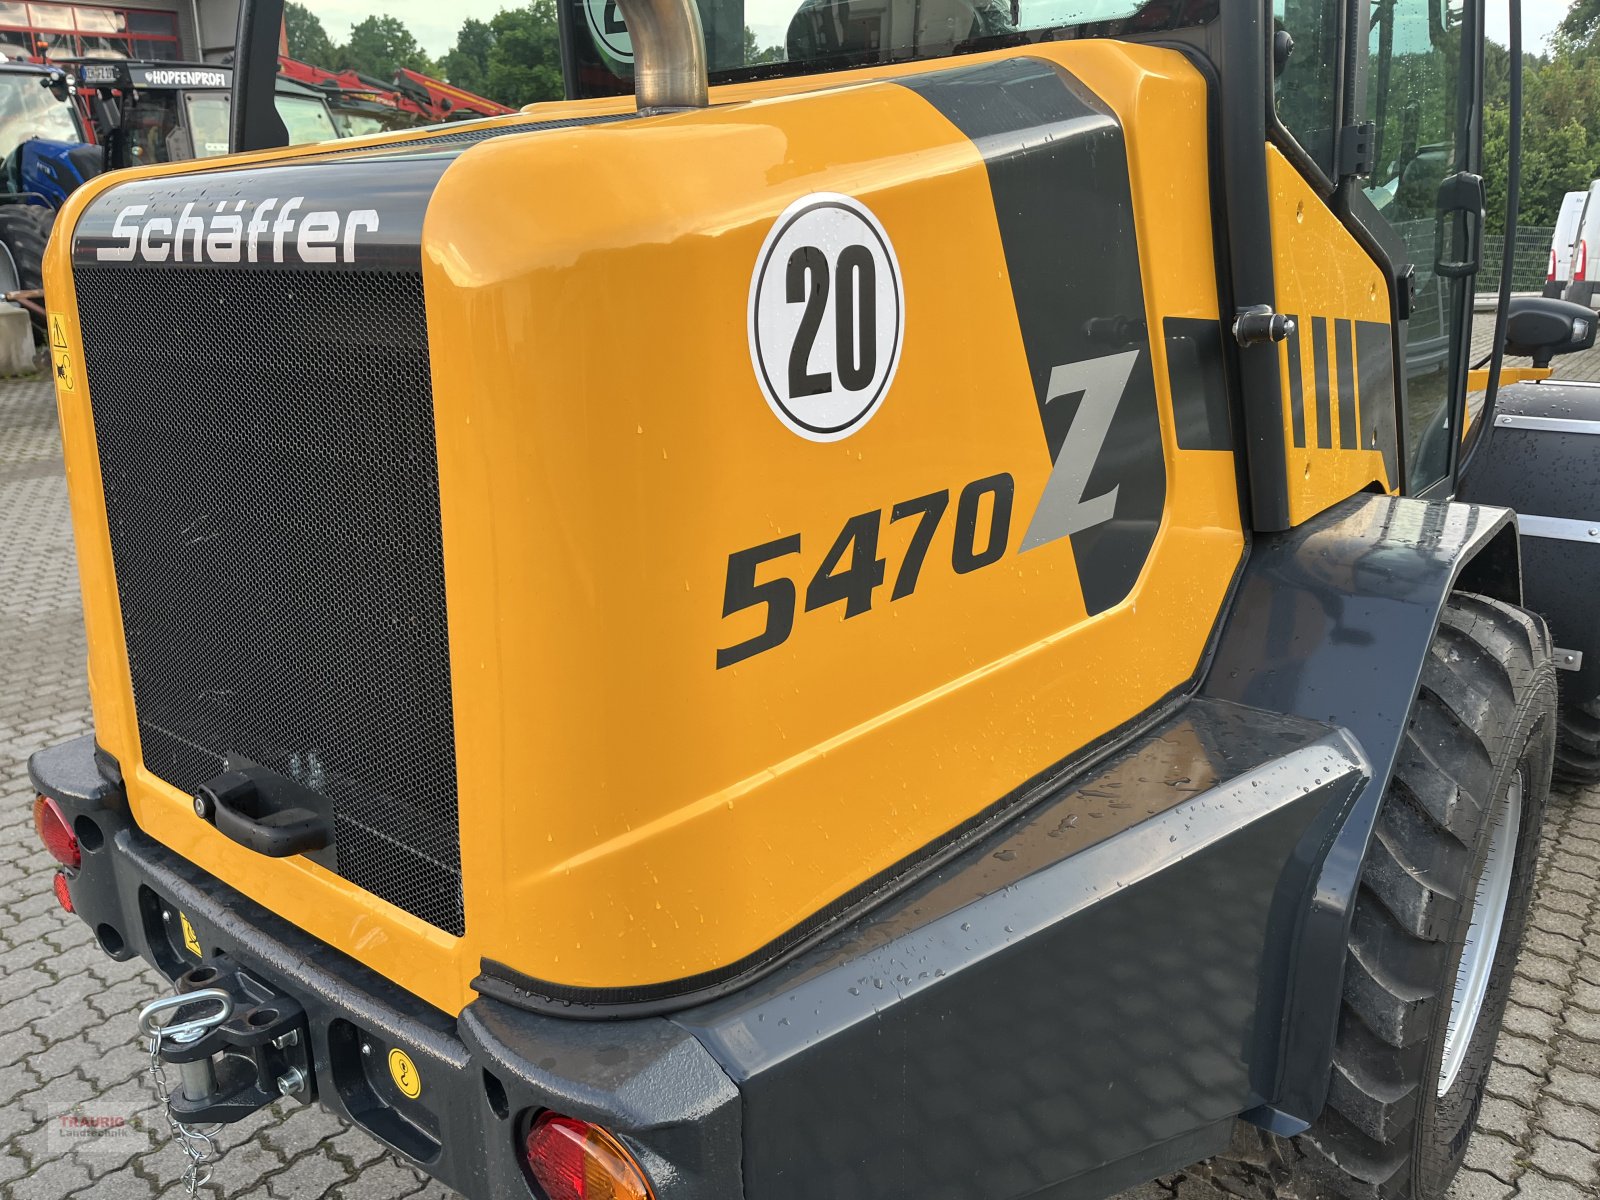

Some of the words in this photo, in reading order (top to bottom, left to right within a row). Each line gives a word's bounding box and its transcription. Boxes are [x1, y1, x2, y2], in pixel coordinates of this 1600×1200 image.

[152, 70, 226, 87] HOPFENPROFI
[97, 196, 380, 263] Schäffer
[785, 244, 877, 399] 20
[716, 472, 1015, 671] 5470
